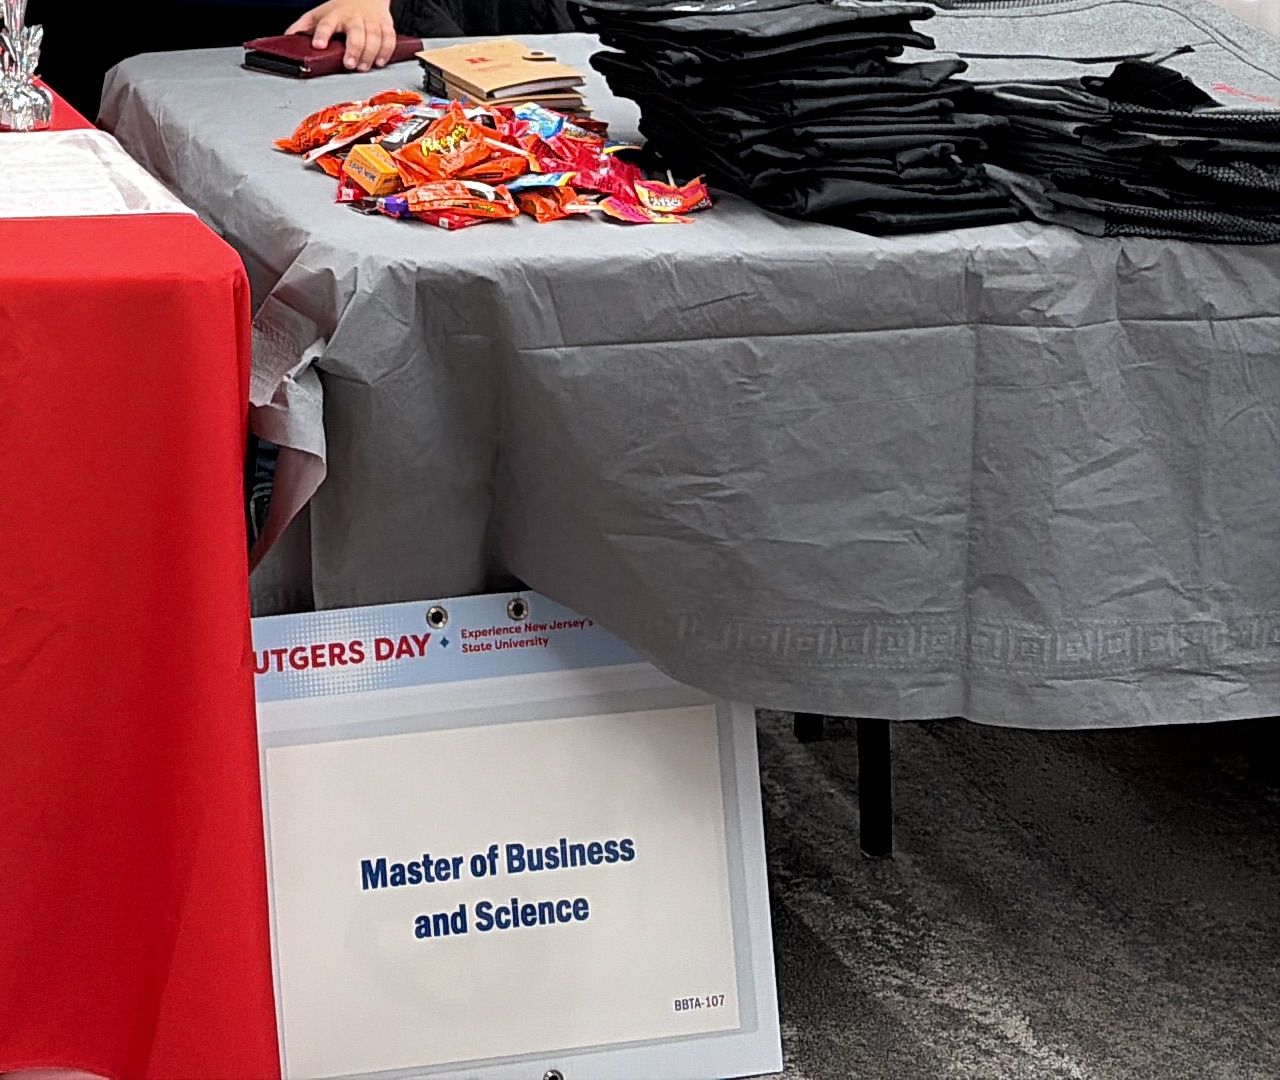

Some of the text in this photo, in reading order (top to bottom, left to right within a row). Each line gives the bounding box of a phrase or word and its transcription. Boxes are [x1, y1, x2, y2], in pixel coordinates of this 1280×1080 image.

[461, 618, 593, 640] Experience New Jersey's
[462, 636, 549, 653] State University
[252, 632, 432, 675] UTGERS DAY
[360, 835, 636, 892] Master of Business
[414, 895, 590, 940] and Science
[674, 994, 726, 1013] BBTA-107
